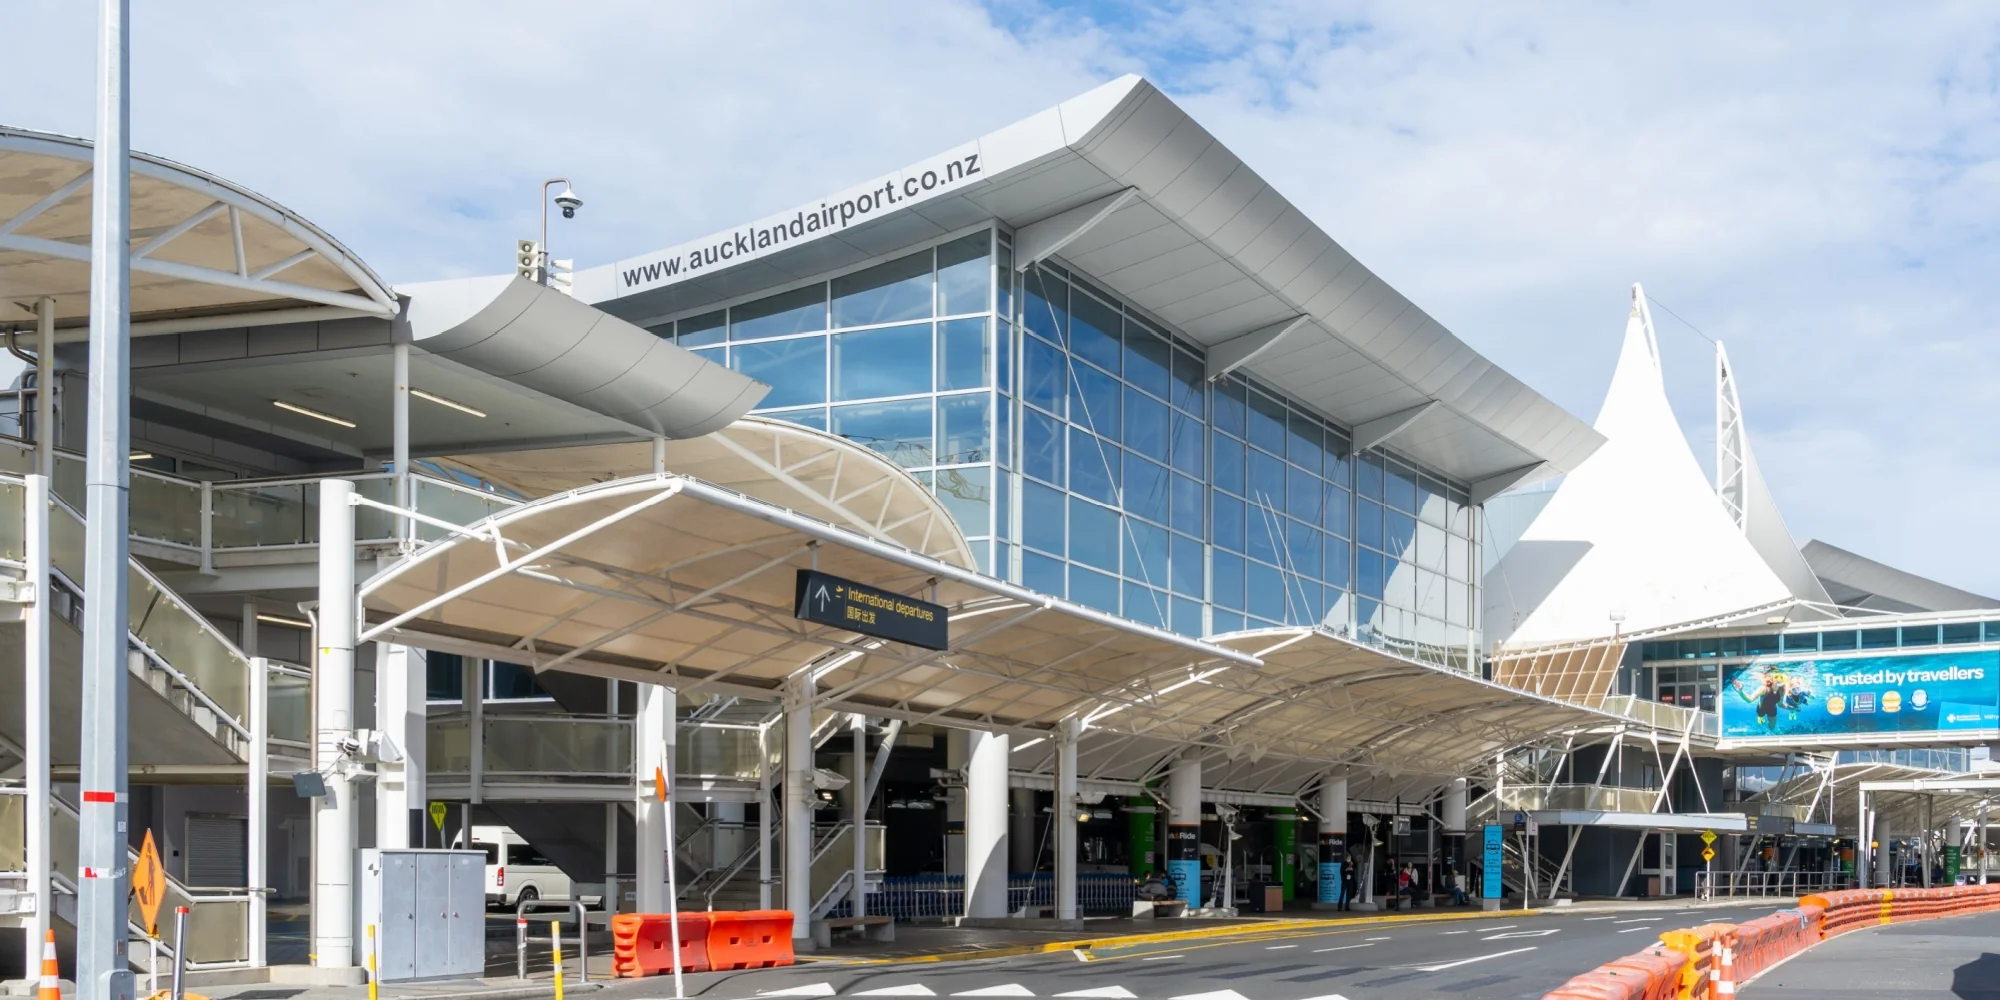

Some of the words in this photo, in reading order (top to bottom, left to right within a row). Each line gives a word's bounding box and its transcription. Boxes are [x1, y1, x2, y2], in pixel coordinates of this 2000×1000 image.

[623, 153, 981, 287] www.aucklandairport.co.nz
[847, 606, 876, 625] 国际出发
[848, 588, 894, 610] International
[896, 602, 934, 621] departures
[1823, 670, 1883, 686] Trusted
[1886, 670, 1905, 686] by
[1907, 666, 1984, 682] travellers
